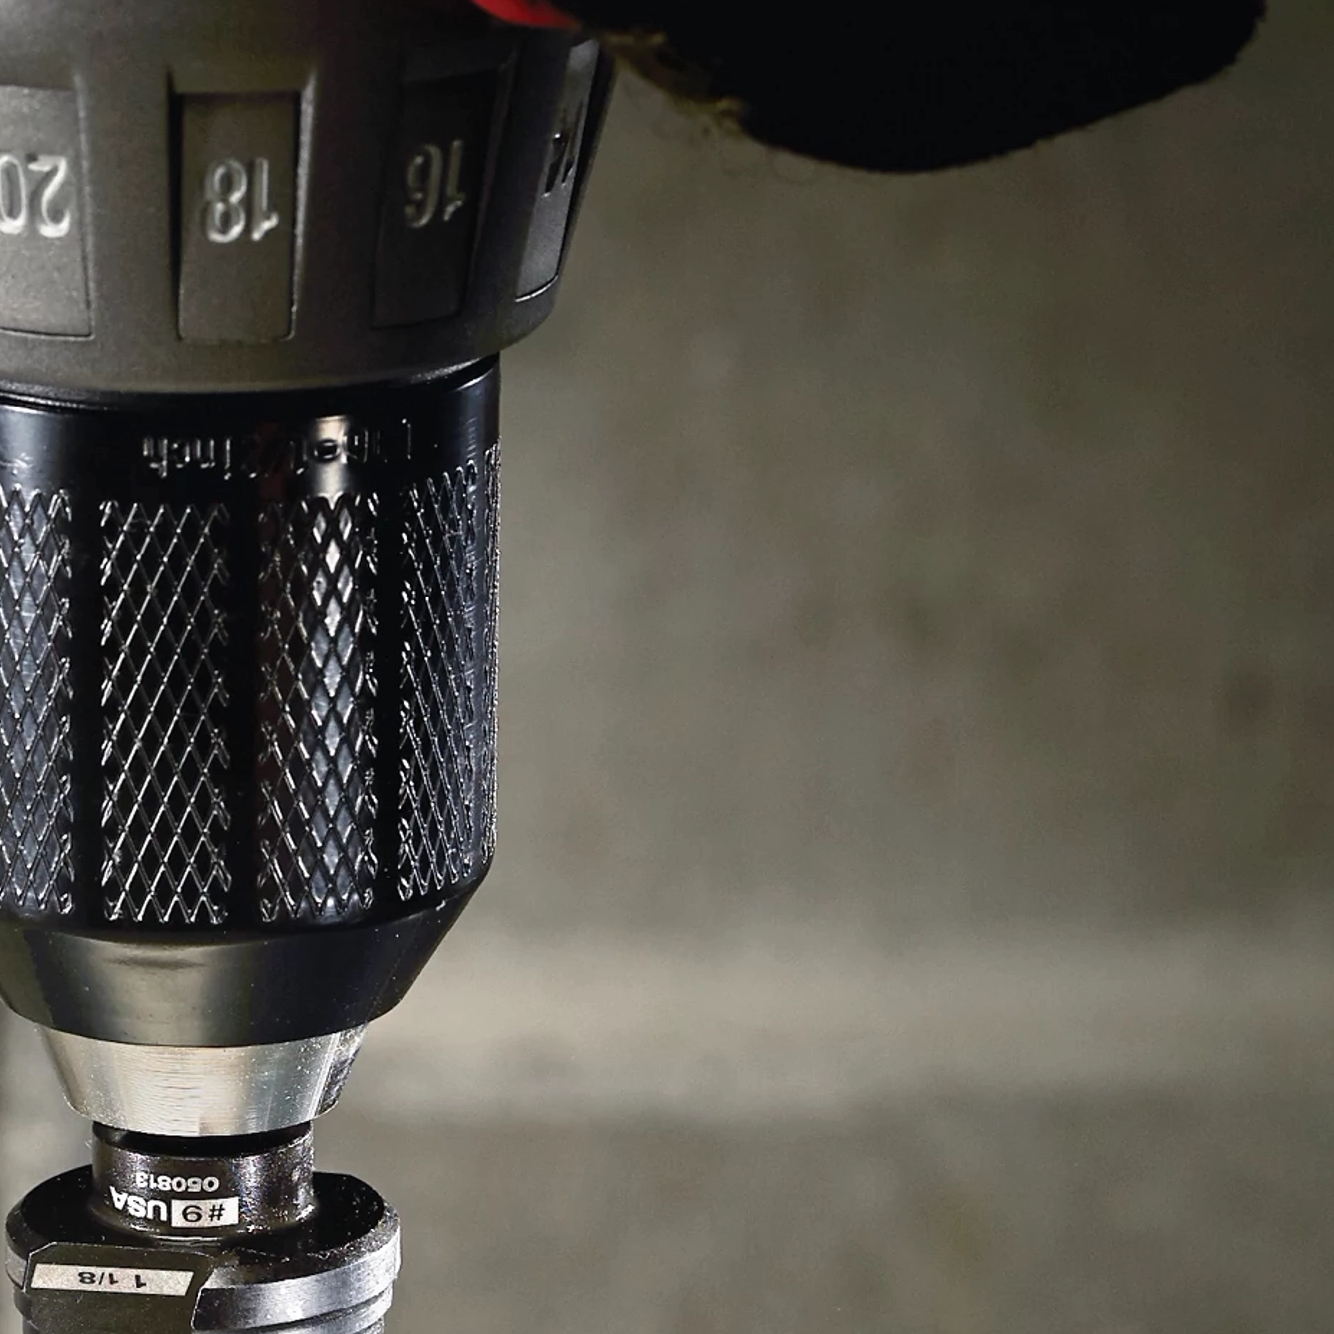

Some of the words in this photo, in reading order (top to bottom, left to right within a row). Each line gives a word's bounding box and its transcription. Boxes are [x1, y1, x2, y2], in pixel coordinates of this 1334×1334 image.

[404, 137, 466, 229] 16
[203, 156, 279, 244] 18
[142, 435, 234, 482] inch
[134, 1170, 220, 1193] 050813
[108, 1185, 169, 1221] USA
[181, 1202, 226, 1223] #9
[77, 1269, 120, 1287] 1/8
[133, 1274, 147, 1290] 1
